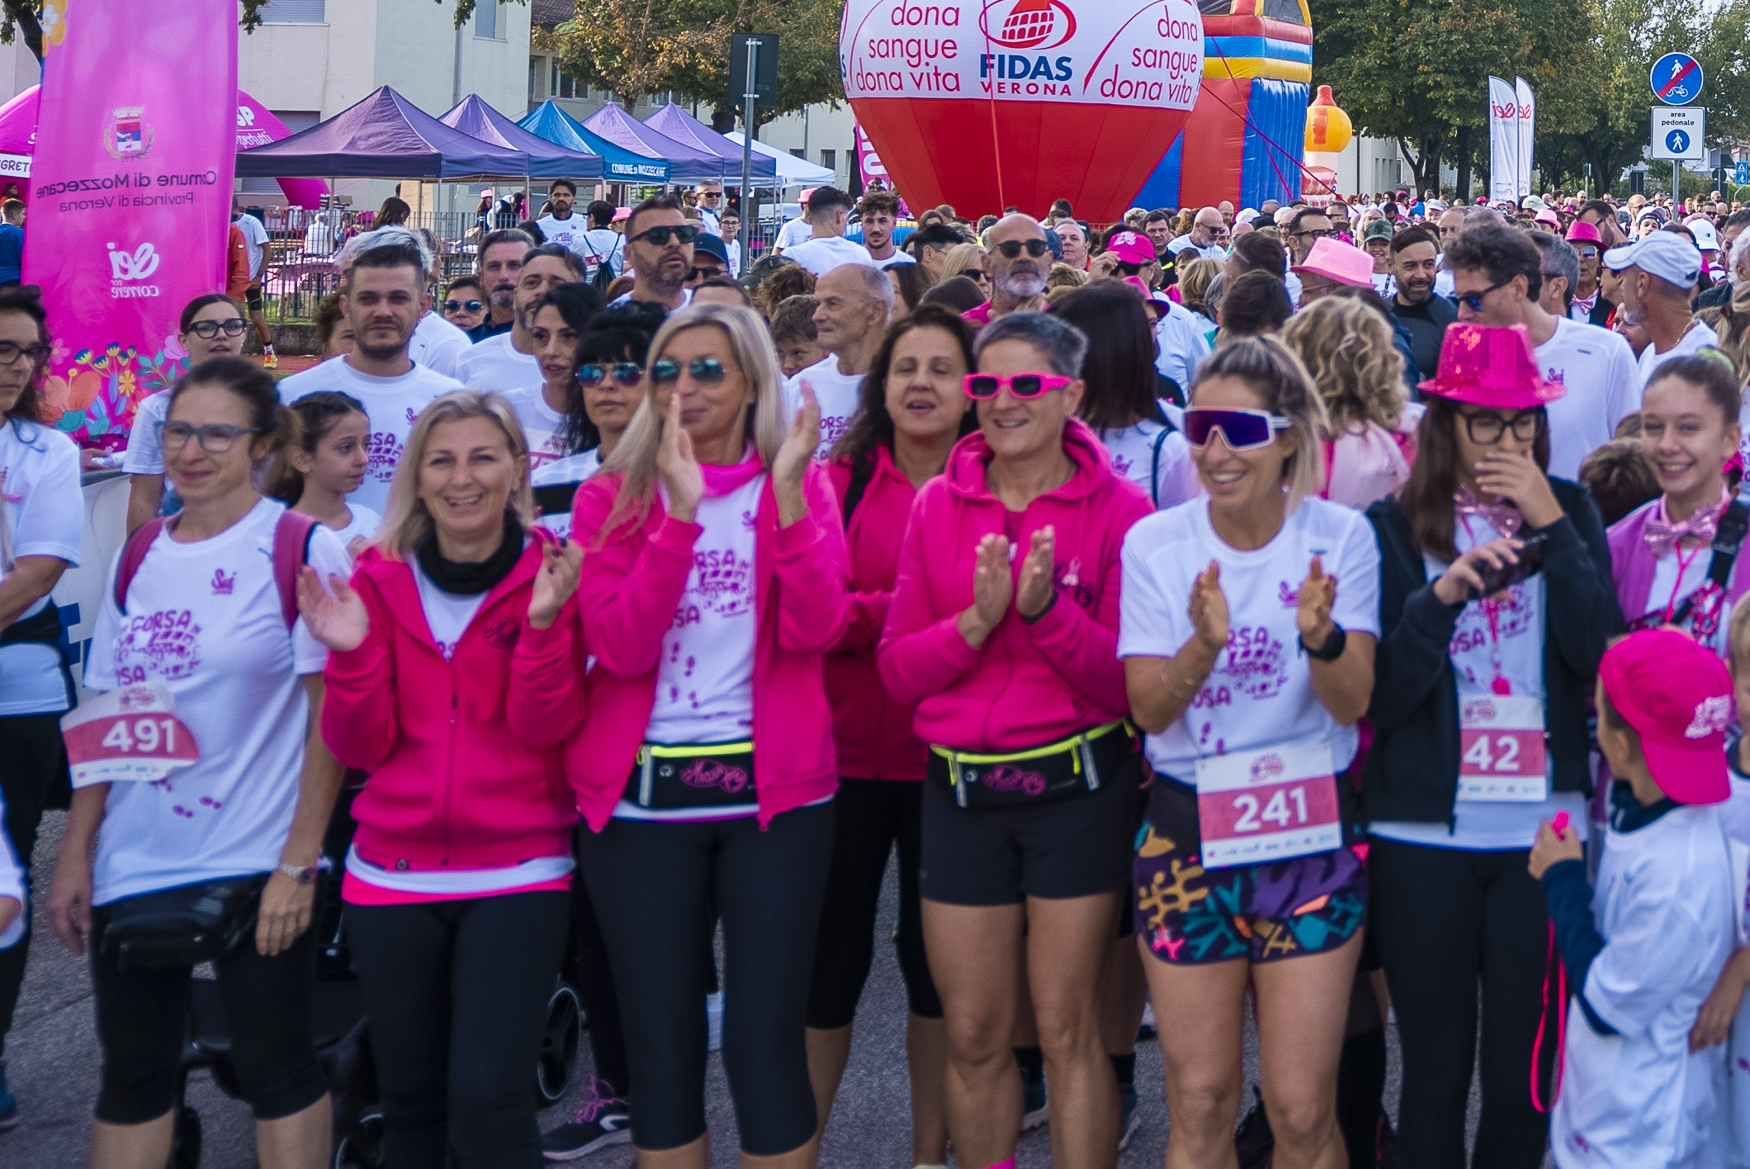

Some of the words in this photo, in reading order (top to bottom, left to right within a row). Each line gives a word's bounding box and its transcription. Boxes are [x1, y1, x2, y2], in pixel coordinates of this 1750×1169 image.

[1157, 5, 1198, 42] dona
[868, 38, 958, 68] sangue
[980, 53, 1073, 81] FIDAS
[1131, 47, 1197, 80] sangue
[856, 57, 904, 91] dona
[909, 61, 961, 92] vita
[980, 81, 1072, 97] VERONA
[1100, 64, 1162, 101] dona
[1168, 74, 1193, 103] vita
[102, 718, 175, 753] 491
[1463, 734, 1520, 772] 42
[1232, 785, 1308, 833] 241
